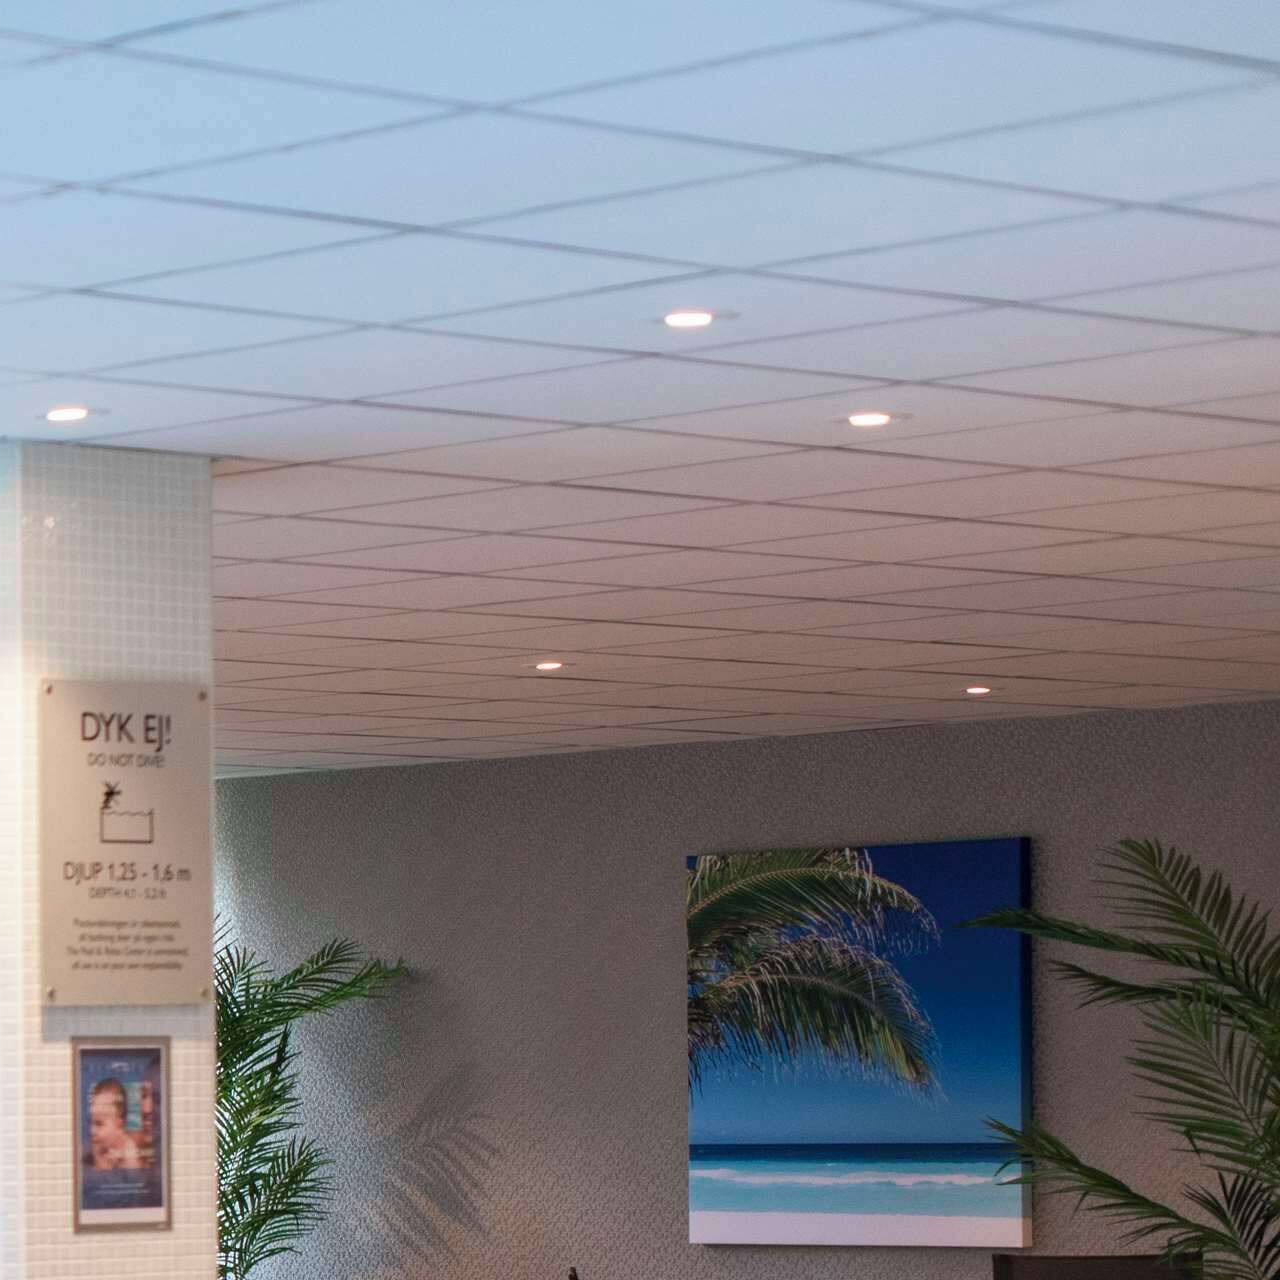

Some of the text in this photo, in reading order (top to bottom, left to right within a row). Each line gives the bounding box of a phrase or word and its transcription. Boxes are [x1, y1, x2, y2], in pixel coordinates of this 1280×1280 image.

[81, 712, 171, 753] DYK EJ!
[63, 861, 102, 885] DJUP
[177, 868, 192, 881] m
